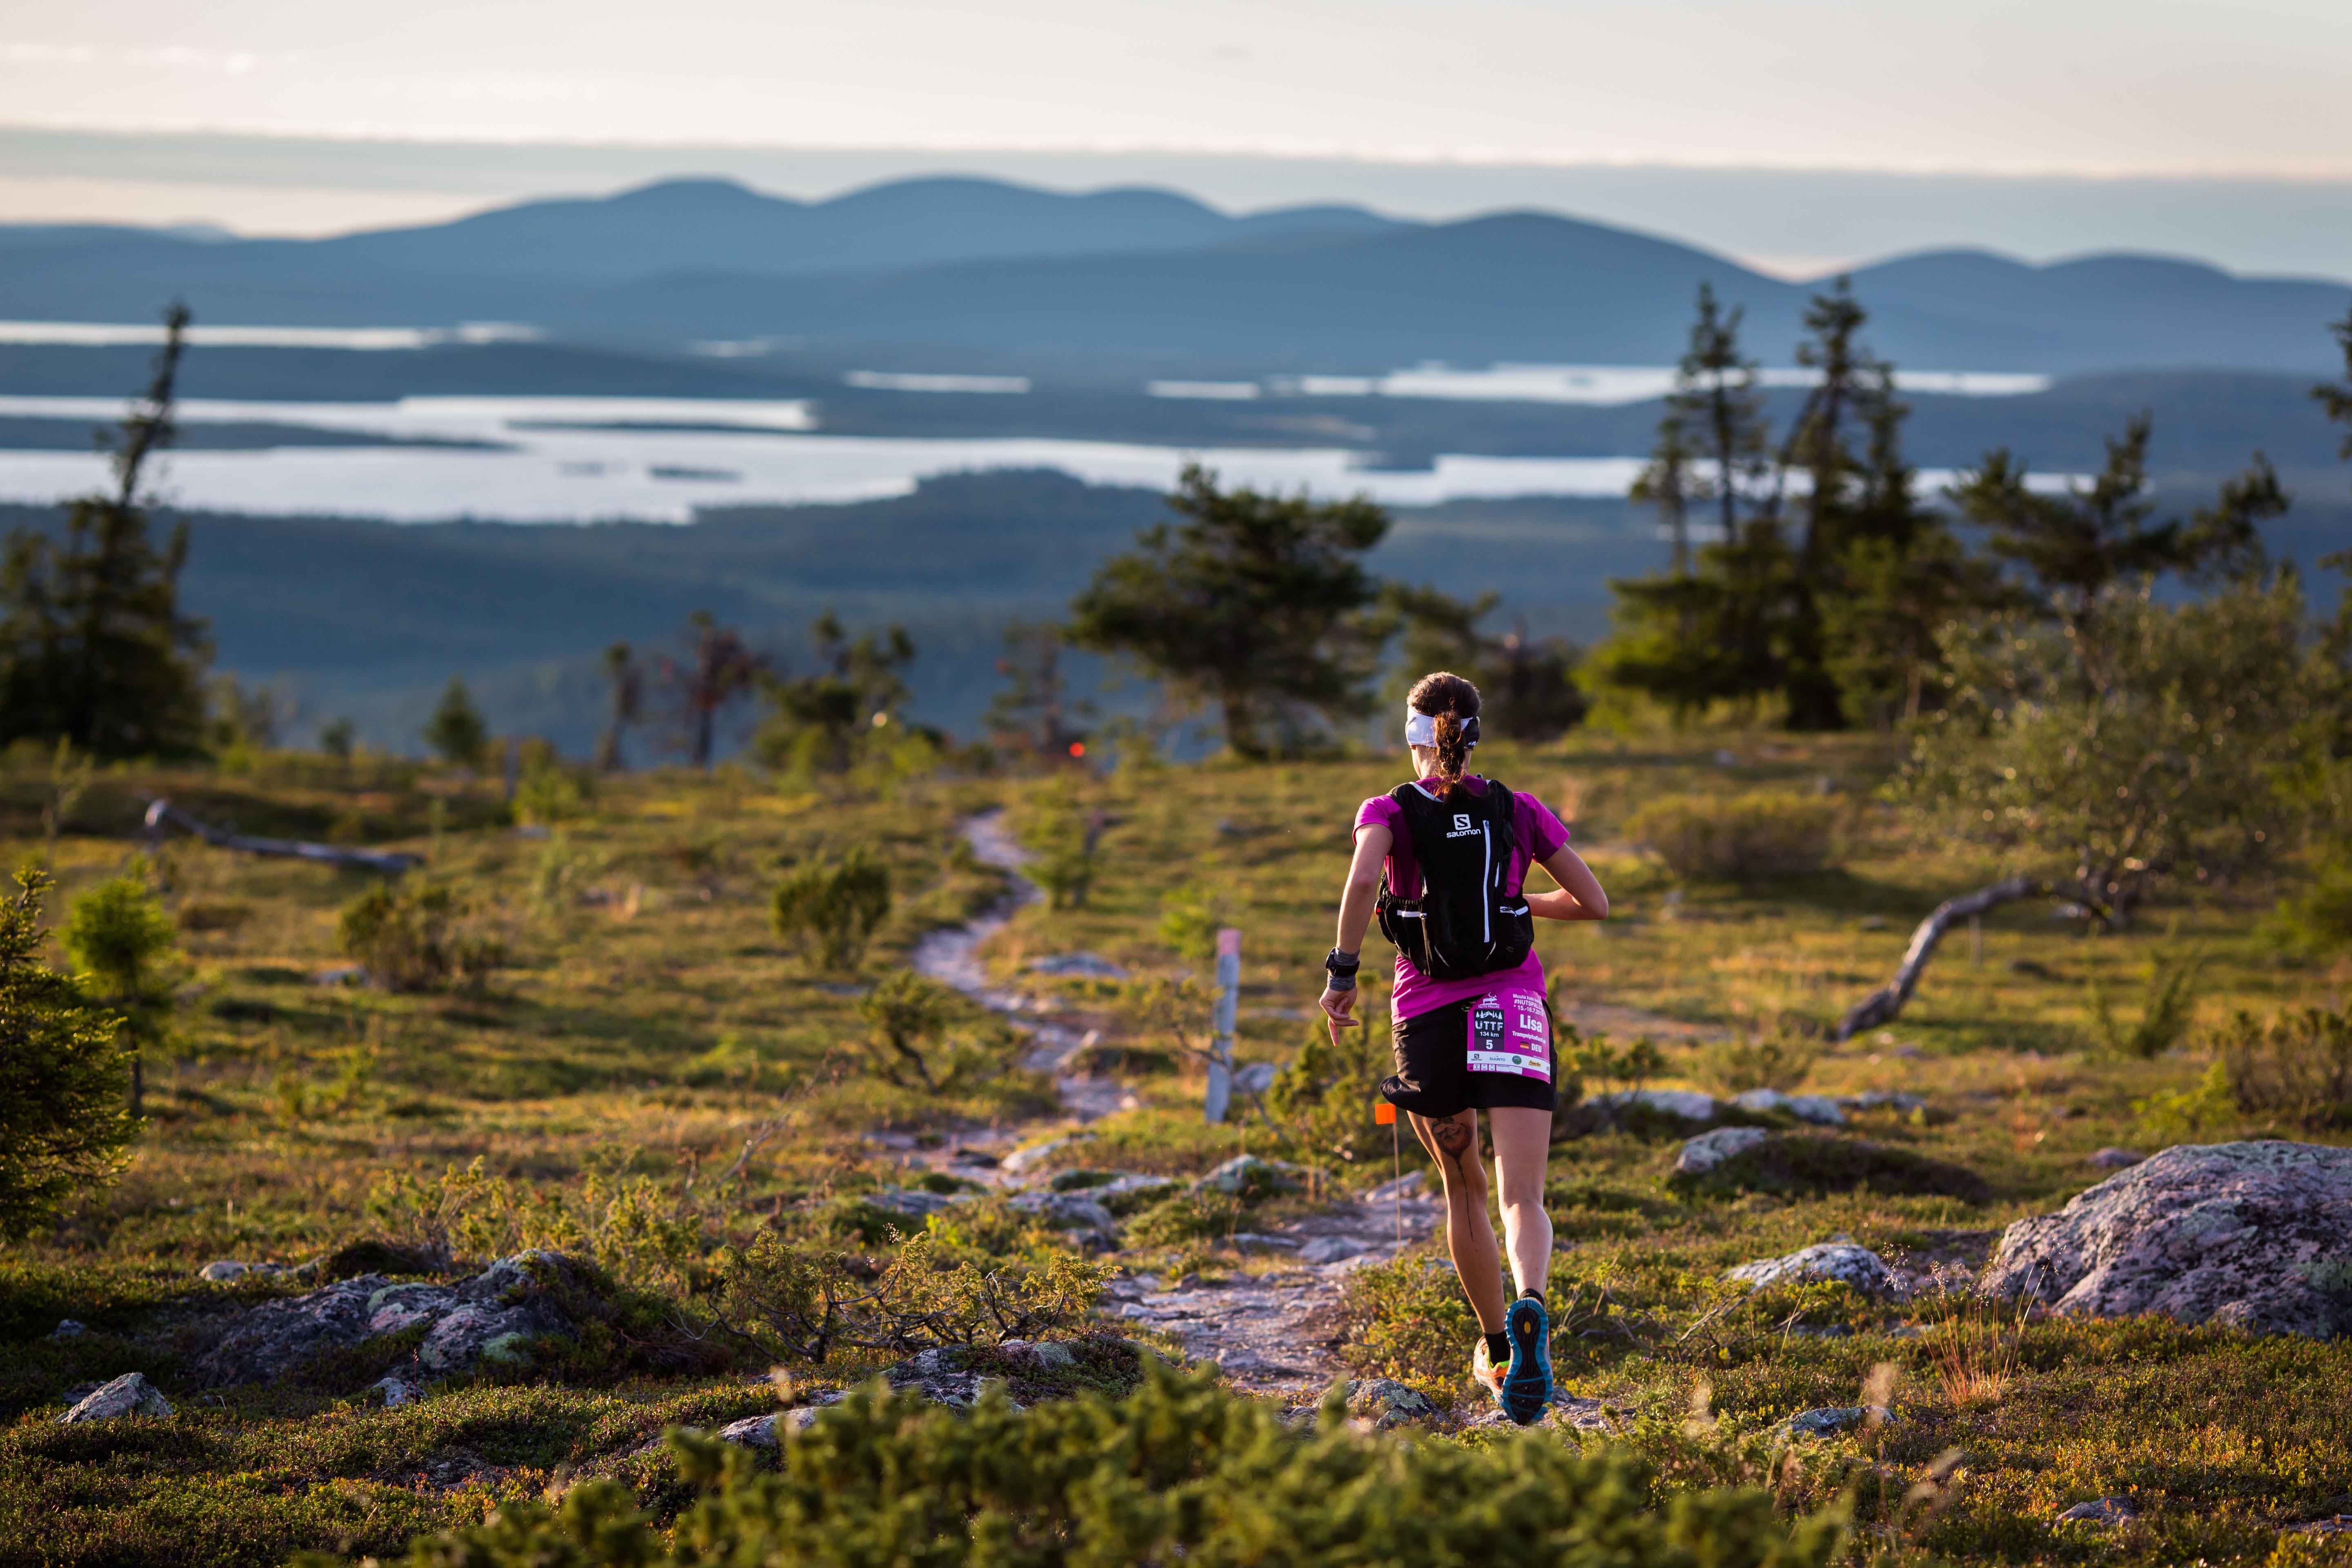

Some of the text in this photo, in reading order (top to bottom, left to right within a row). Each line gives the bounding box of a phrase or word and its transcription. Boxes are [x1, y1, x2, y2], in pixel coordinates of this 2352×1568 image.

[1475, 1020, 1503, 1031] UTTF
[1520, 1014, 1542, 1033] Lisa
[1486, 1039, 1493, 1050] 5
[1531, 1043, 1542, 1053] DEU
